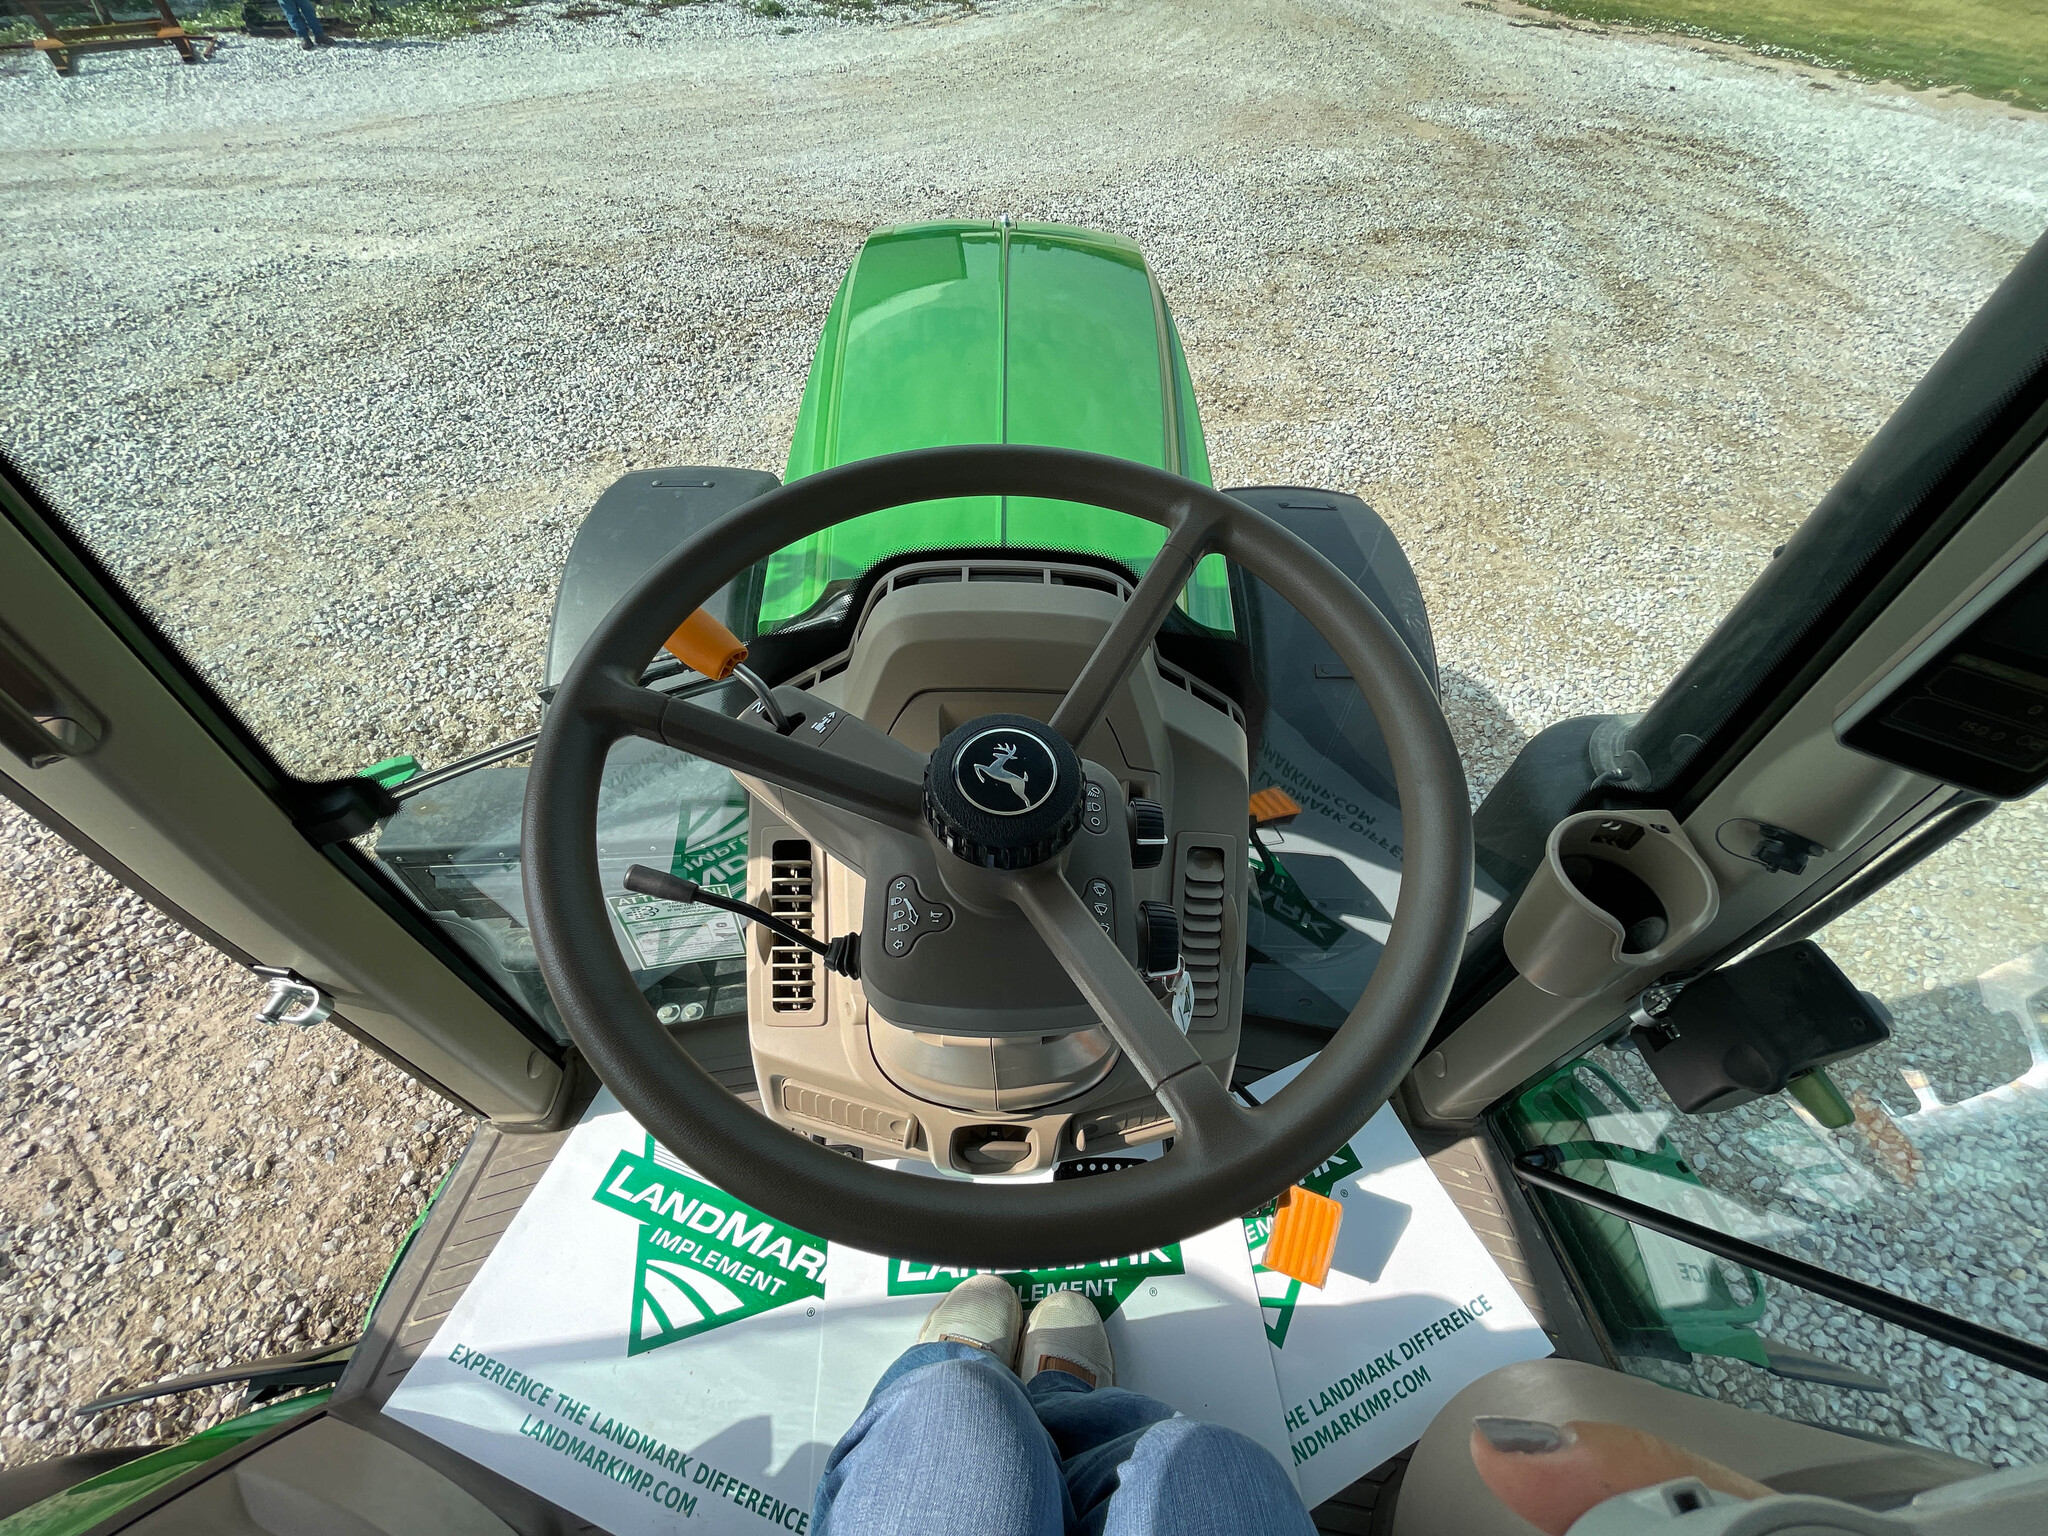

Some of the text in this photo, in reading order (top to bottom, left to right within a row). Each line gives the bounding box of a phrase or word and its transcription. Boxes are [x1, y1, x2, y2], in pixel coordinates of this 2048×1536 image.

[751, 701, 766, 714] N
[649, 1227, 787, 1296] IMPLEMENT
[1018, 1277, 1118, 1303] LEMENT
[1284, 1293, 1494, 1433] HE LANDMARK DIFFERENCE
[447, 1343, 811, 1536] EXPERIENCE THE LANDMARK DIFFERENCE
[518, 1413, 699, 1518] LANDMARKIMP.COM
[1290, 1364, 1432, 1467] NDMARKIMP.COM
